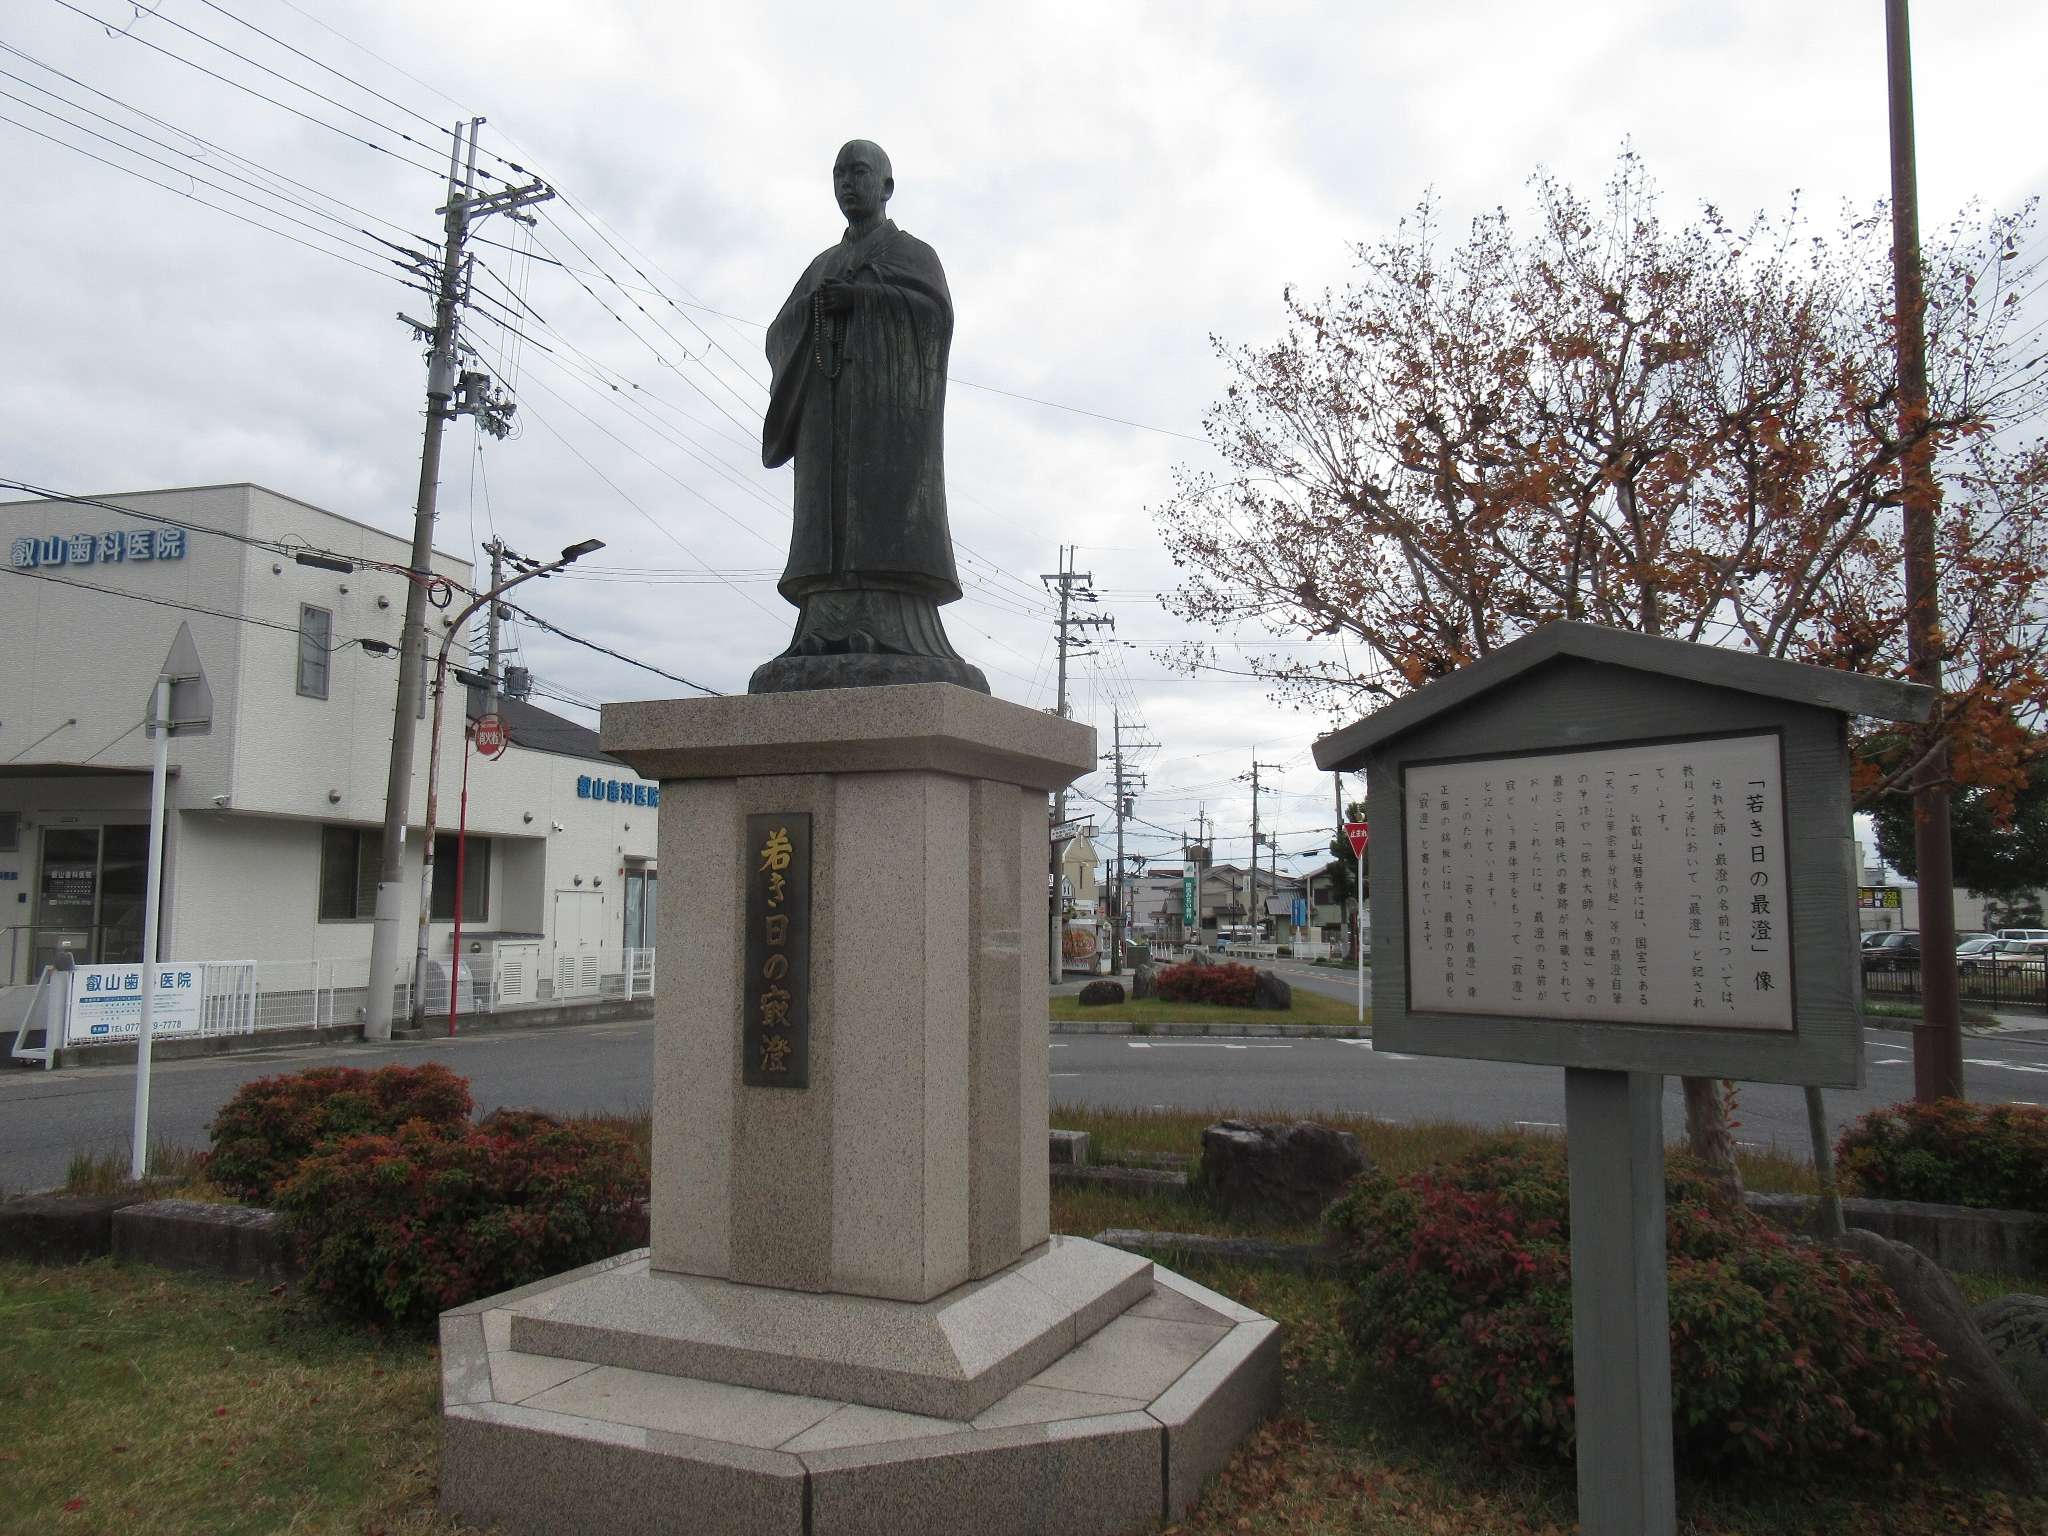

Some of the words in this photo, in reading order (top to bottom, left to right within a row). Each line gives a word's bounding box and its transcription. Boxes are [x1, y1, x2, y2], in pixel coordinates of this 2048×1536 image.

[12, 528, 186, 568] 叡山歯科医院
[479, 731, 500, 745] 消火栓
[577, 774, 660, 808] 叡山歯科医院
[1350, 829, 1367, 838] 止まれ
[86, 972, 192, 991] 叡山歯医院
[111, 1025, 123, 1033] TEL
